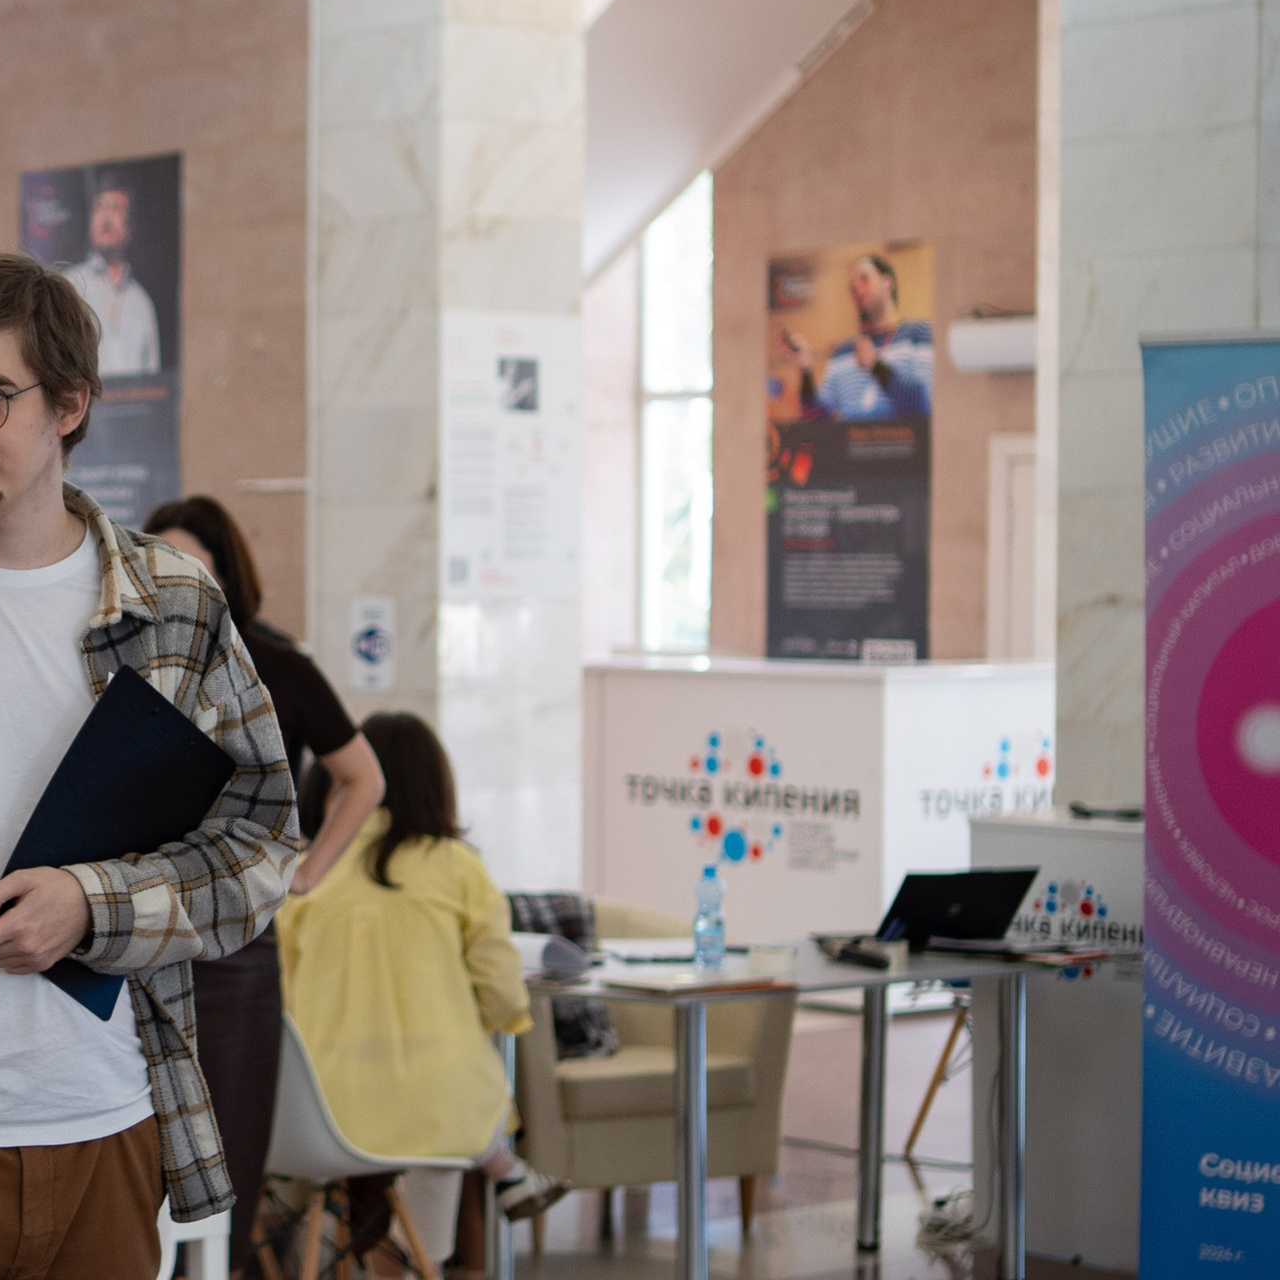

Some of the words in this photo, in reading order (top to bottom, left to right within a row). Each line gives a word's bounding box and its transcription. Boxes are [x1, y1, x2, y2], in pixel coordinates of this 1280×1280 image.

[625, 773, 712, 810] точка
[723, 780, 861, 819] кипения
[1199, 1186, 1265, 1214] квиз
